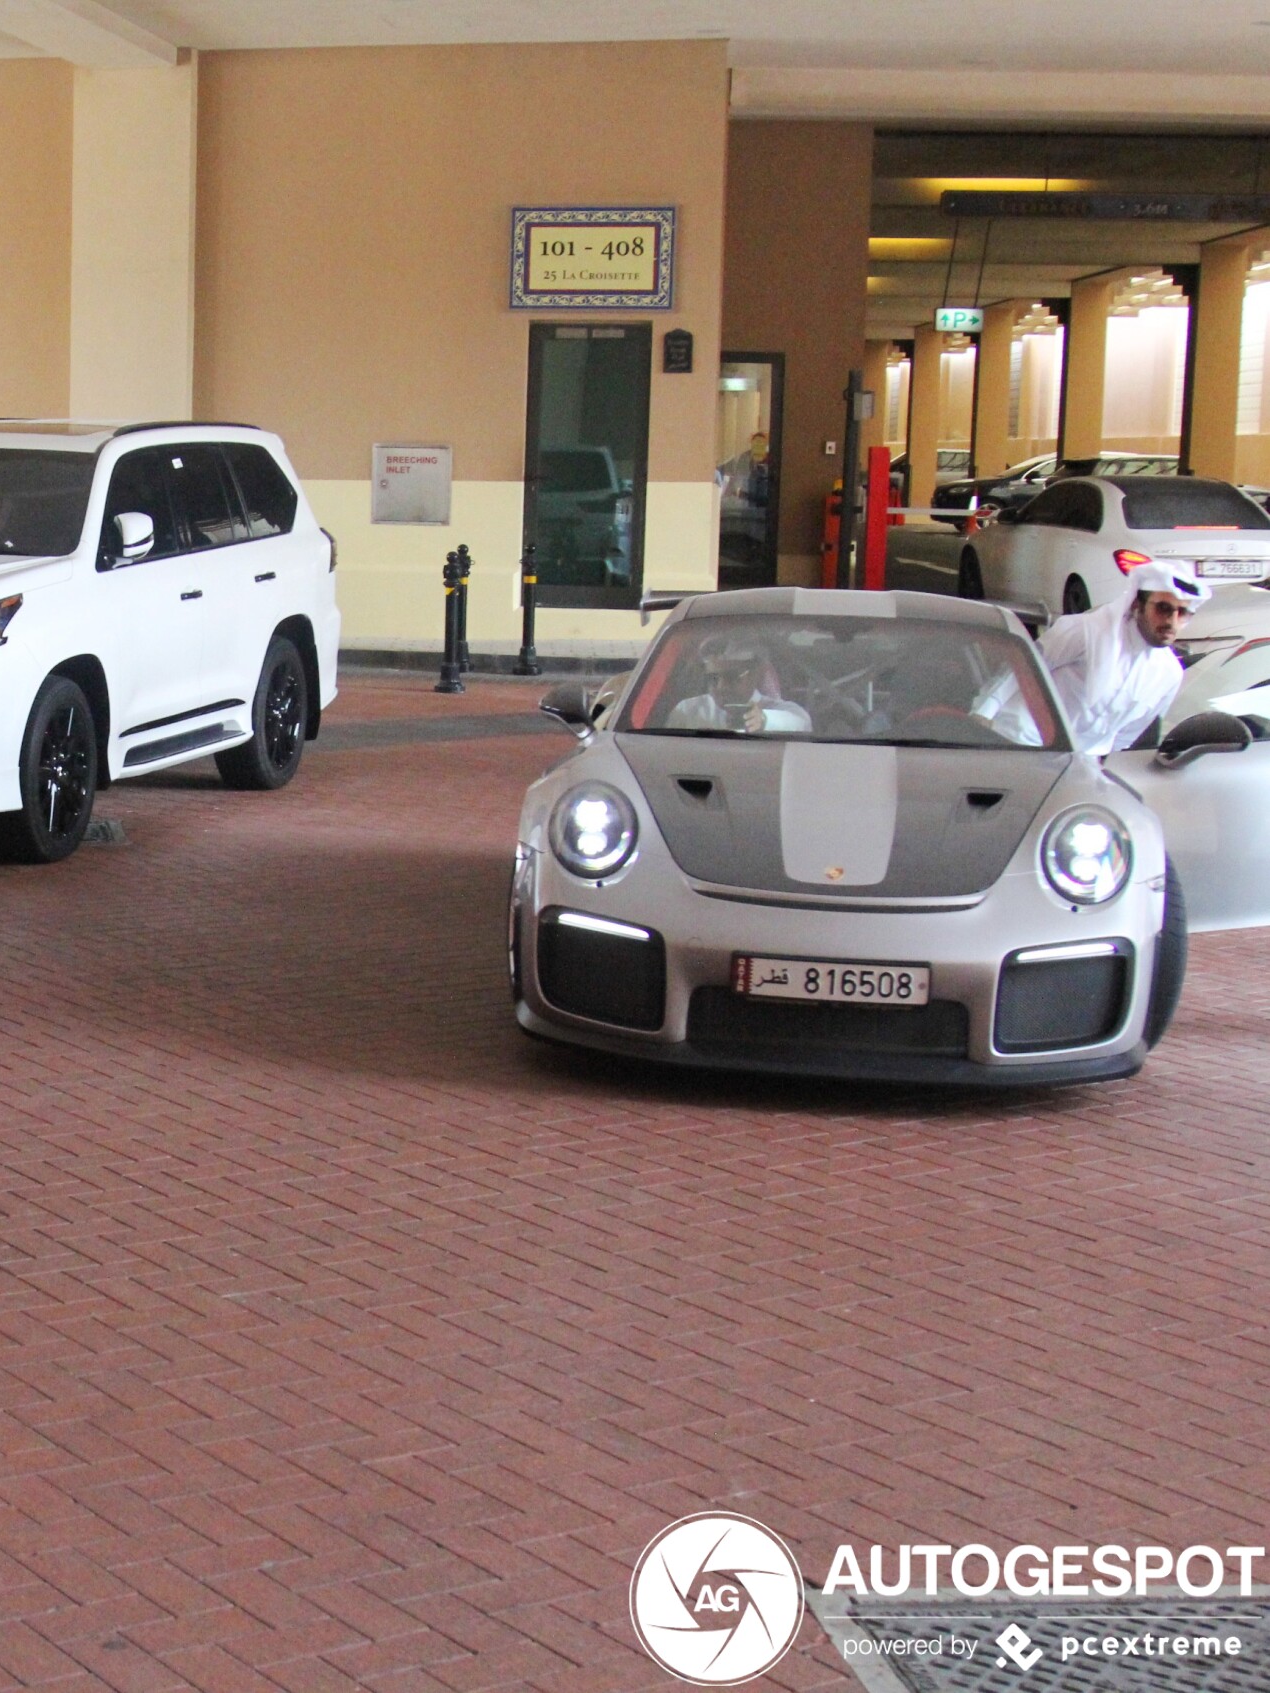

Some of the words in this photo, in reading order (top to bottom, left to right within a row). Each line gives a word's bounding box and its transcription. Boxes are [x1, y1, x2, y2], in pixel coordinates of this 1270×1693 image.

[540, 240, 576, 256] 101
[601, 236, 644, 261] 408
[543, 270, 557, 281] 25
[953, 311, 967, 328] P
[386, 456, 438, 464] BREECHING
[386, 466, 411, 474] INLET
[753, 968, 789, 987] قطر
[804, 967, 912, 999] 816508
